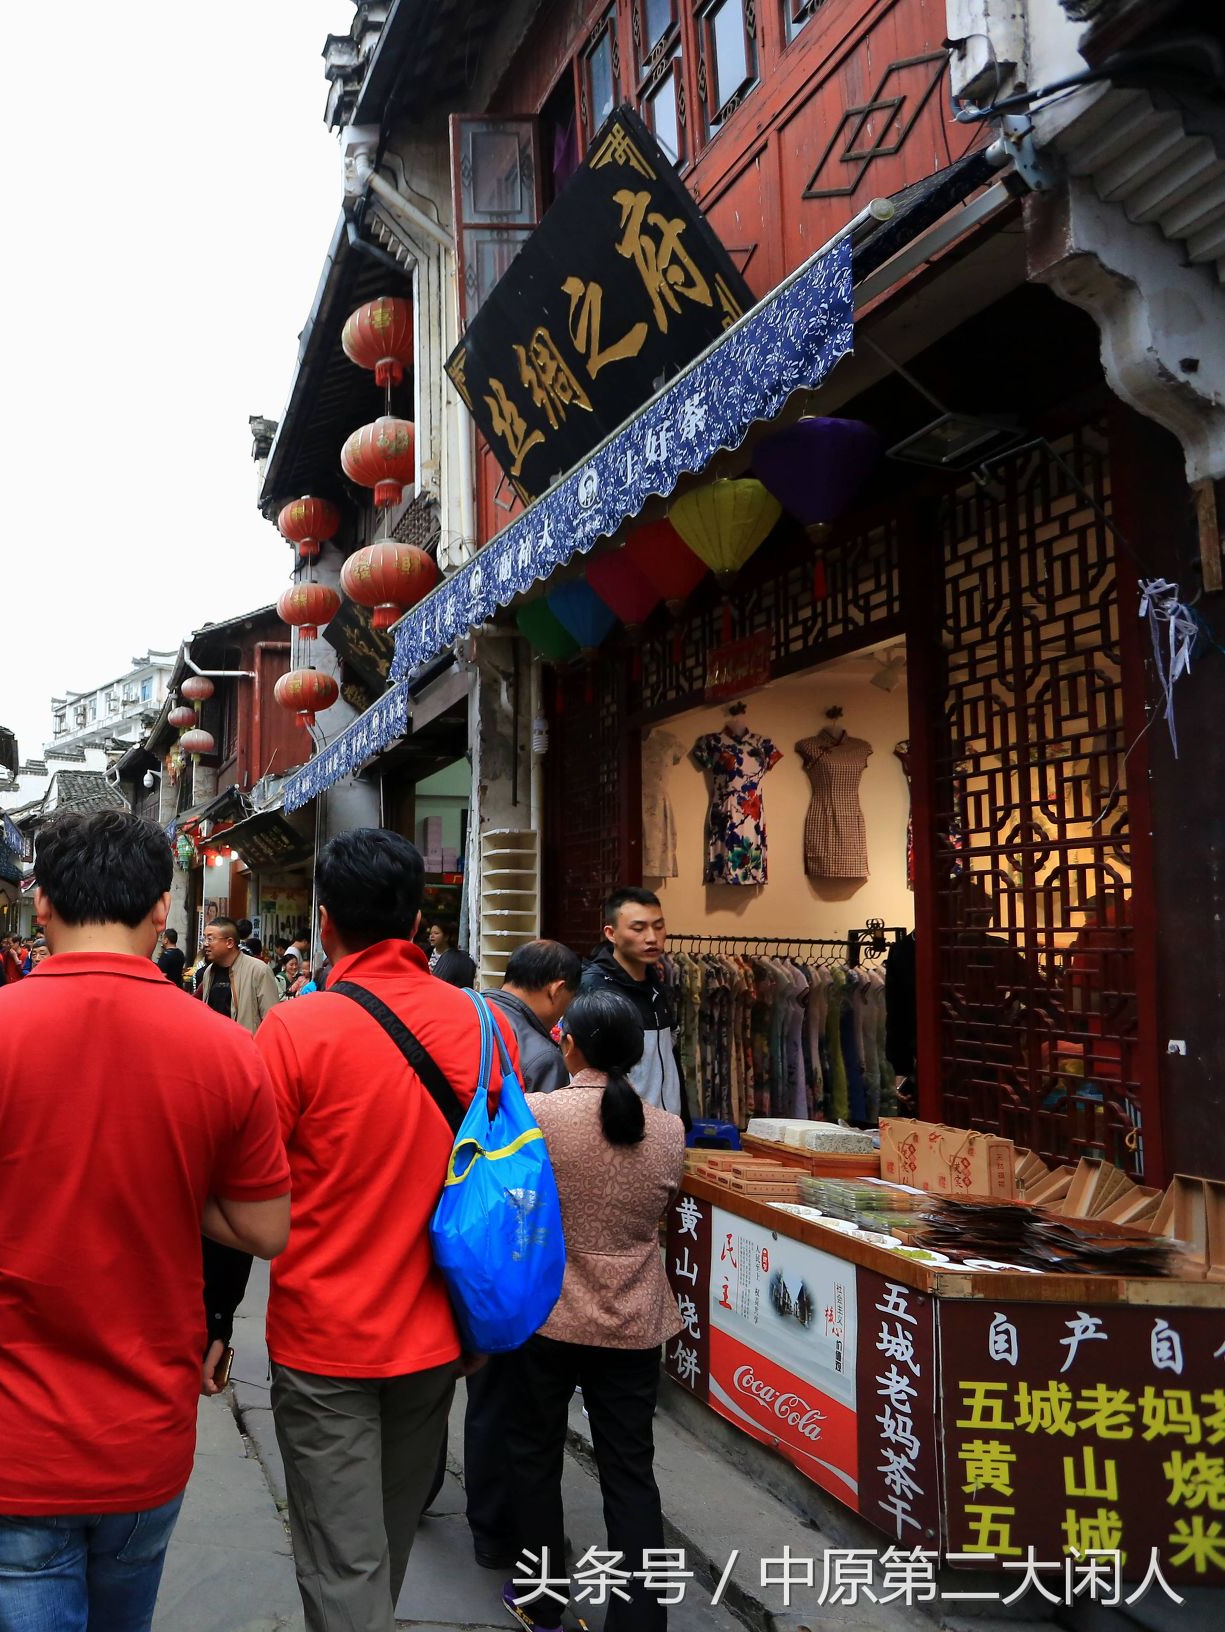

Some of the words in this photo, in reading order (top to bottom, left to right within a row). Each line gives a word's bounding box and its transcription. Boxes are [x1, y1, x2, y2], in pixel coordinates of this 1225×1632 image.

[617, 391, 709, 491] 上好茶
[671, 1198, 702, 1391] 黄山烧饼
[719, 1233, 738, 1310] 民主
[988, 1311, 1225, 1376] 自产自
[733, 1364, 823, 1443] Coca-Cola
[875, 1282, 925, 1541] 五城老妈茶干
